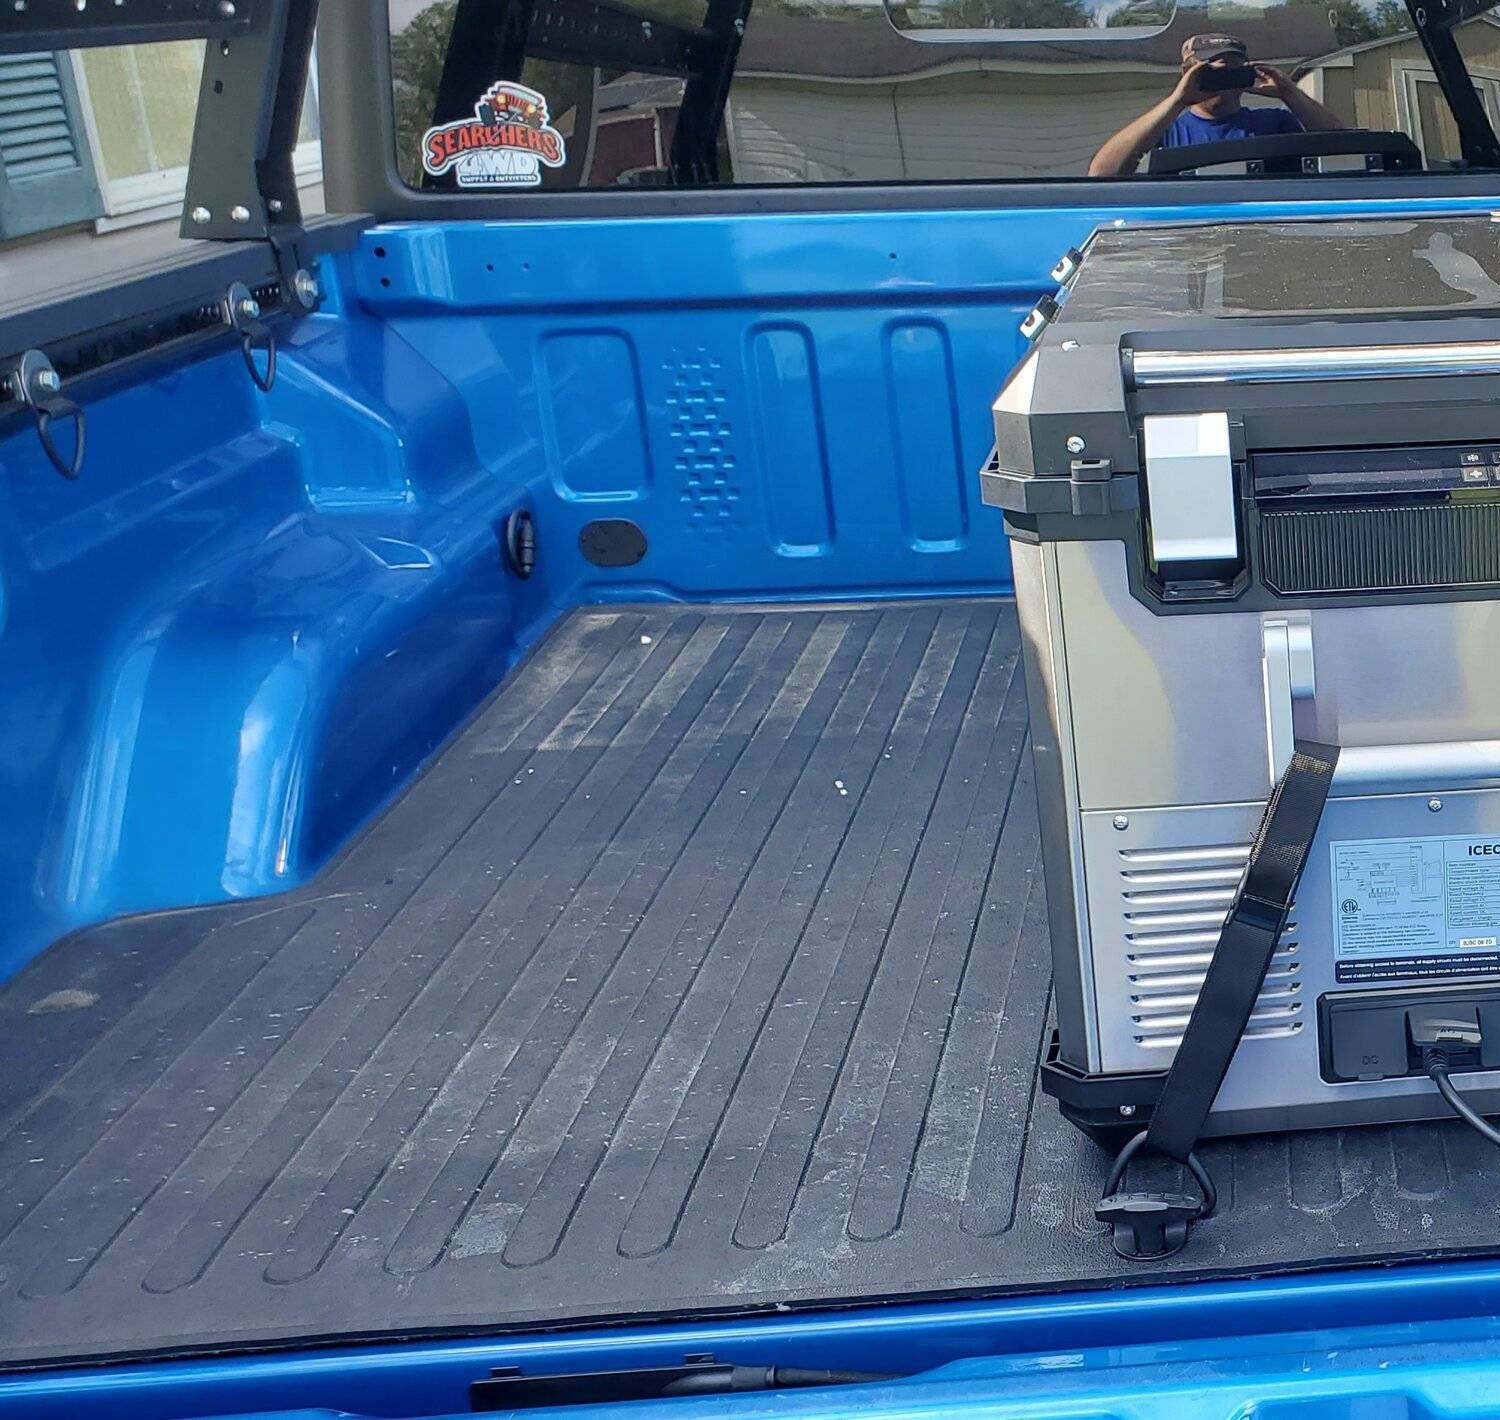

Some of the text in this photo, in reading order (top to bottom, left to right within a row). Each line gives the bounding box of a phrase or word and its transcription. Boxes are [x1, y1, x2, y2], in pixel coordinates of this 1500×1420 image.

[429, 124, 560, 167] SEARCHERS
[459, 151, 536, 175] 4WD
[1362, 1055, 1379, 1064] DC
